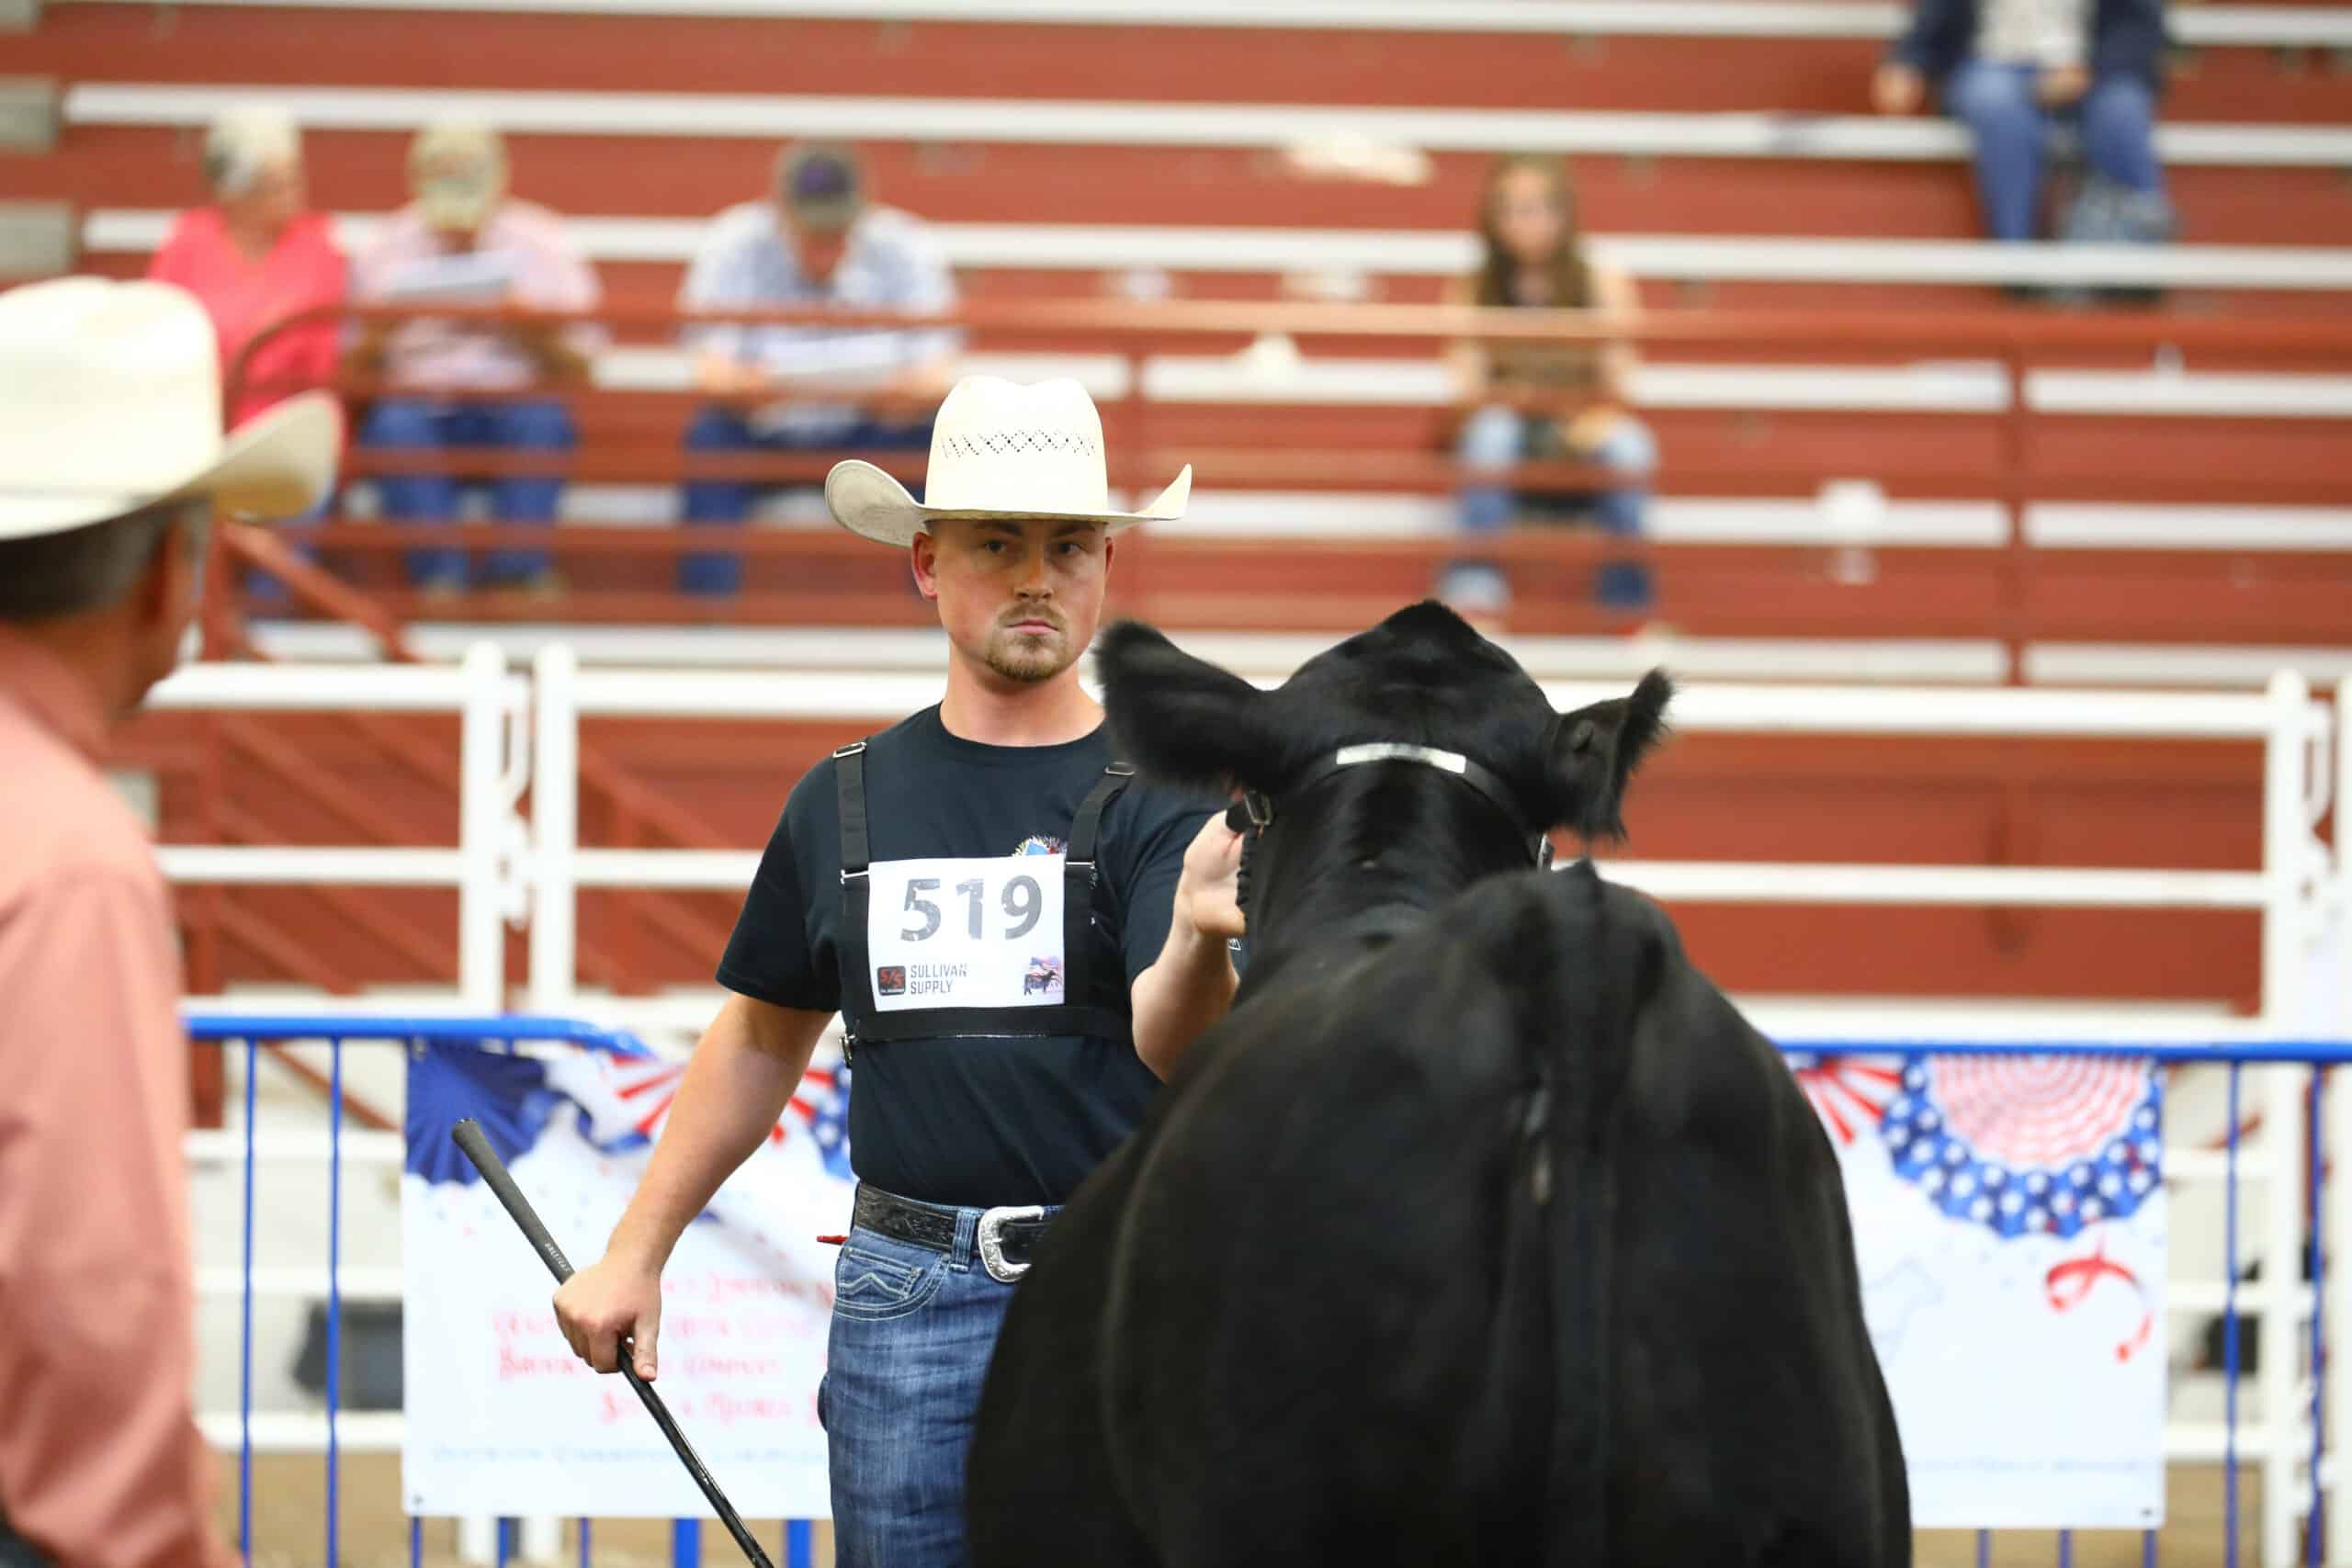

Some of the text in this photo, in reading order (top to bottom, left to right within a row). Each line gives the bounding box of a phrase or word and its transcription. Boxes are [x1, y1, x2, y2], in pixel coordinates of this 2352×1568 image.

[899, 874, 1043, 942] 519
[910, 963, 967, 978] SULLIVAN
[910, 979, 954, 995] SUPPLY
